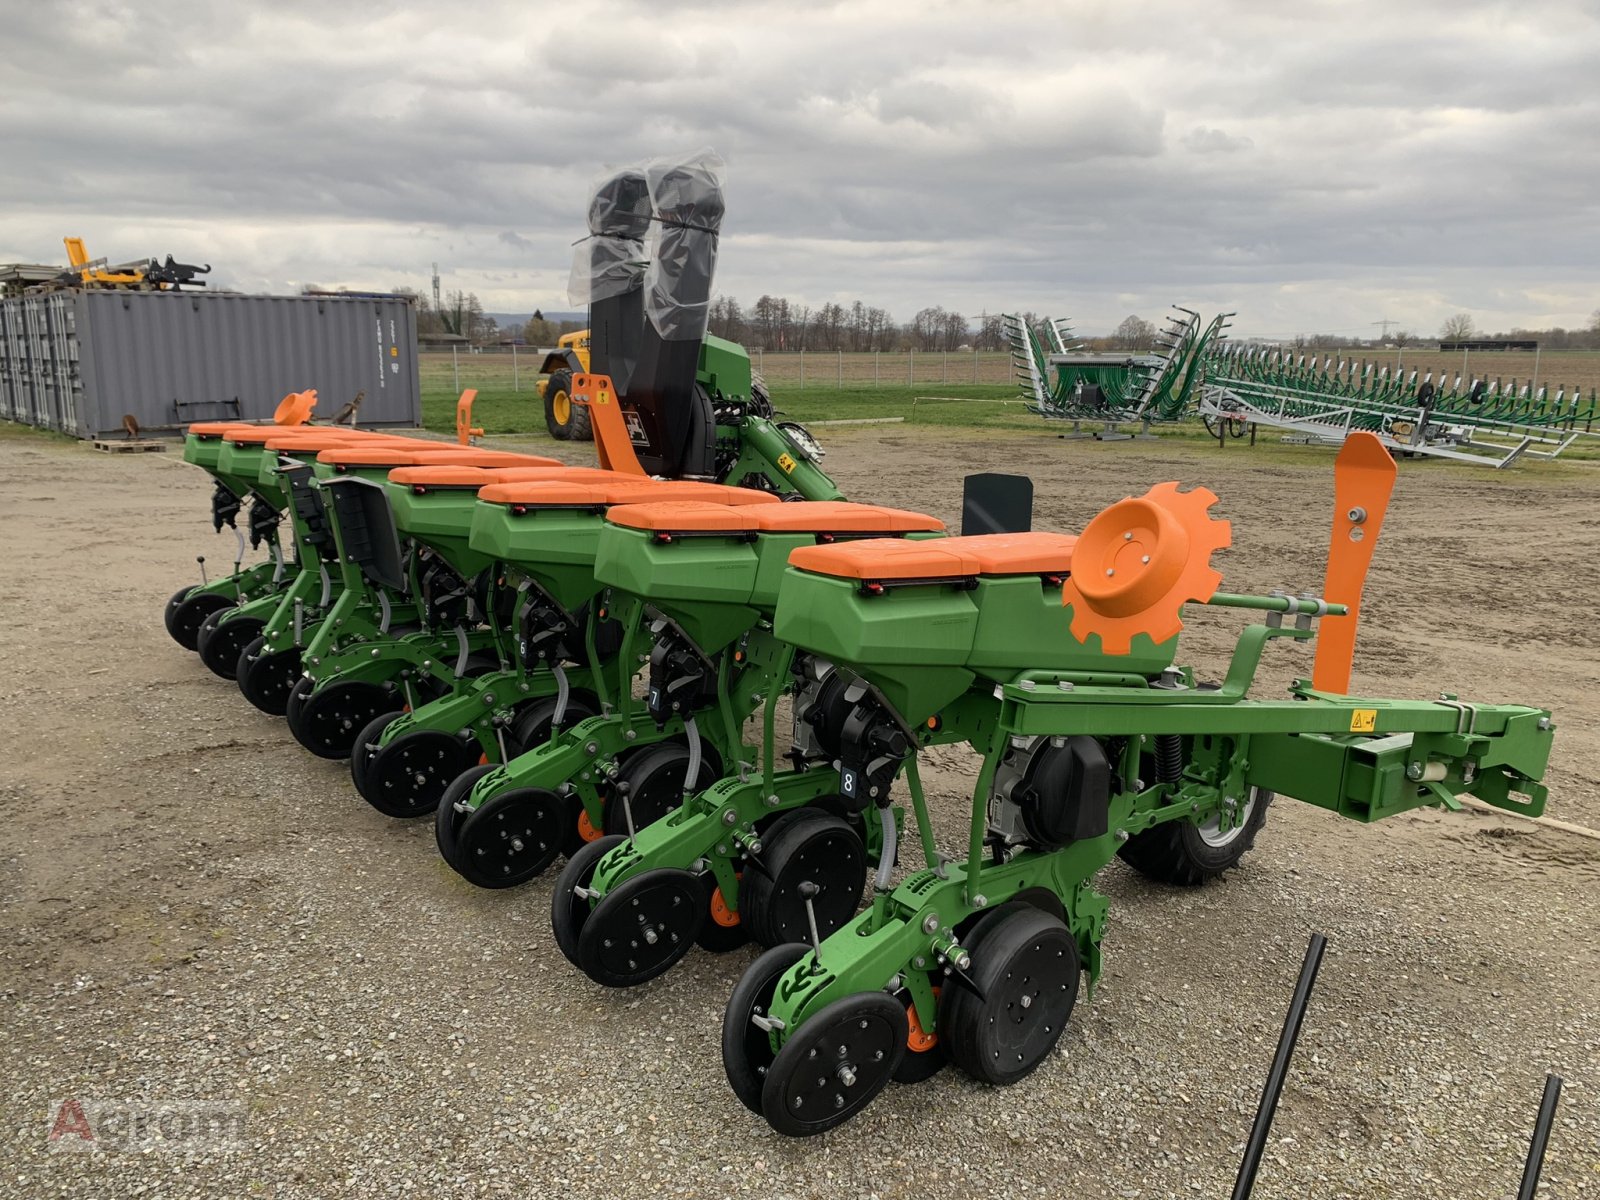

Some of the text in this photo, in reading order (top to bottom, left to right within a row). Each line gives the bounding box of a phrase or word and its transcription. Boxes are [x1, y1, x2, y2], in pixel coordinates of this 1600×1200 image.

[520, 641, 526, 655] 6
[651, 690, 658, 705] 7
[844, 773, 853, 792] 8
